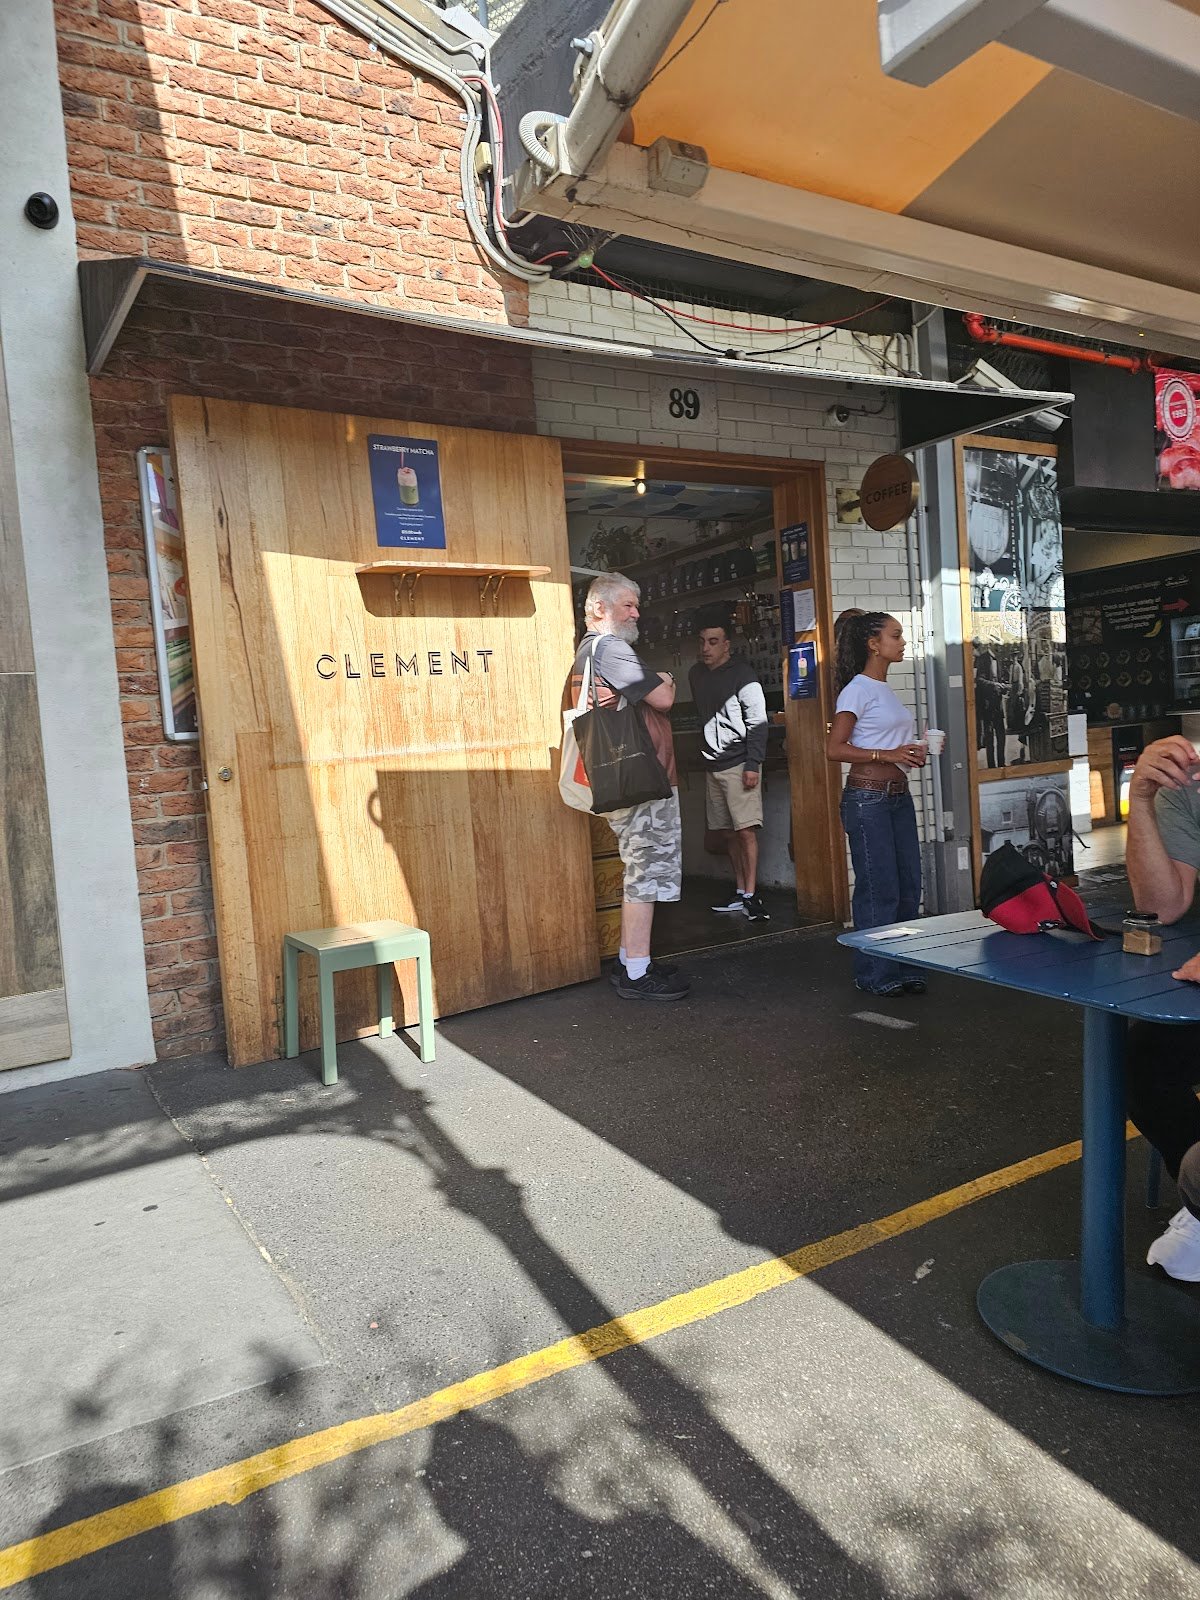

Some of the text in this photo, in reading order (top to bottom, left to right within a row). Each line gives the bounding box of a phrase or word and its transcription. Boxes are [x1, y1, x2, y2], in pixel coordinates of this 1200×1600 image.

[669, 388, 700, 420] 89
[373, 443, 435, 456] STRAWBERRY MATCHA
[866, 481, 908, 505] COFFEE
[316, 650, 493, 680] CLEMENT
